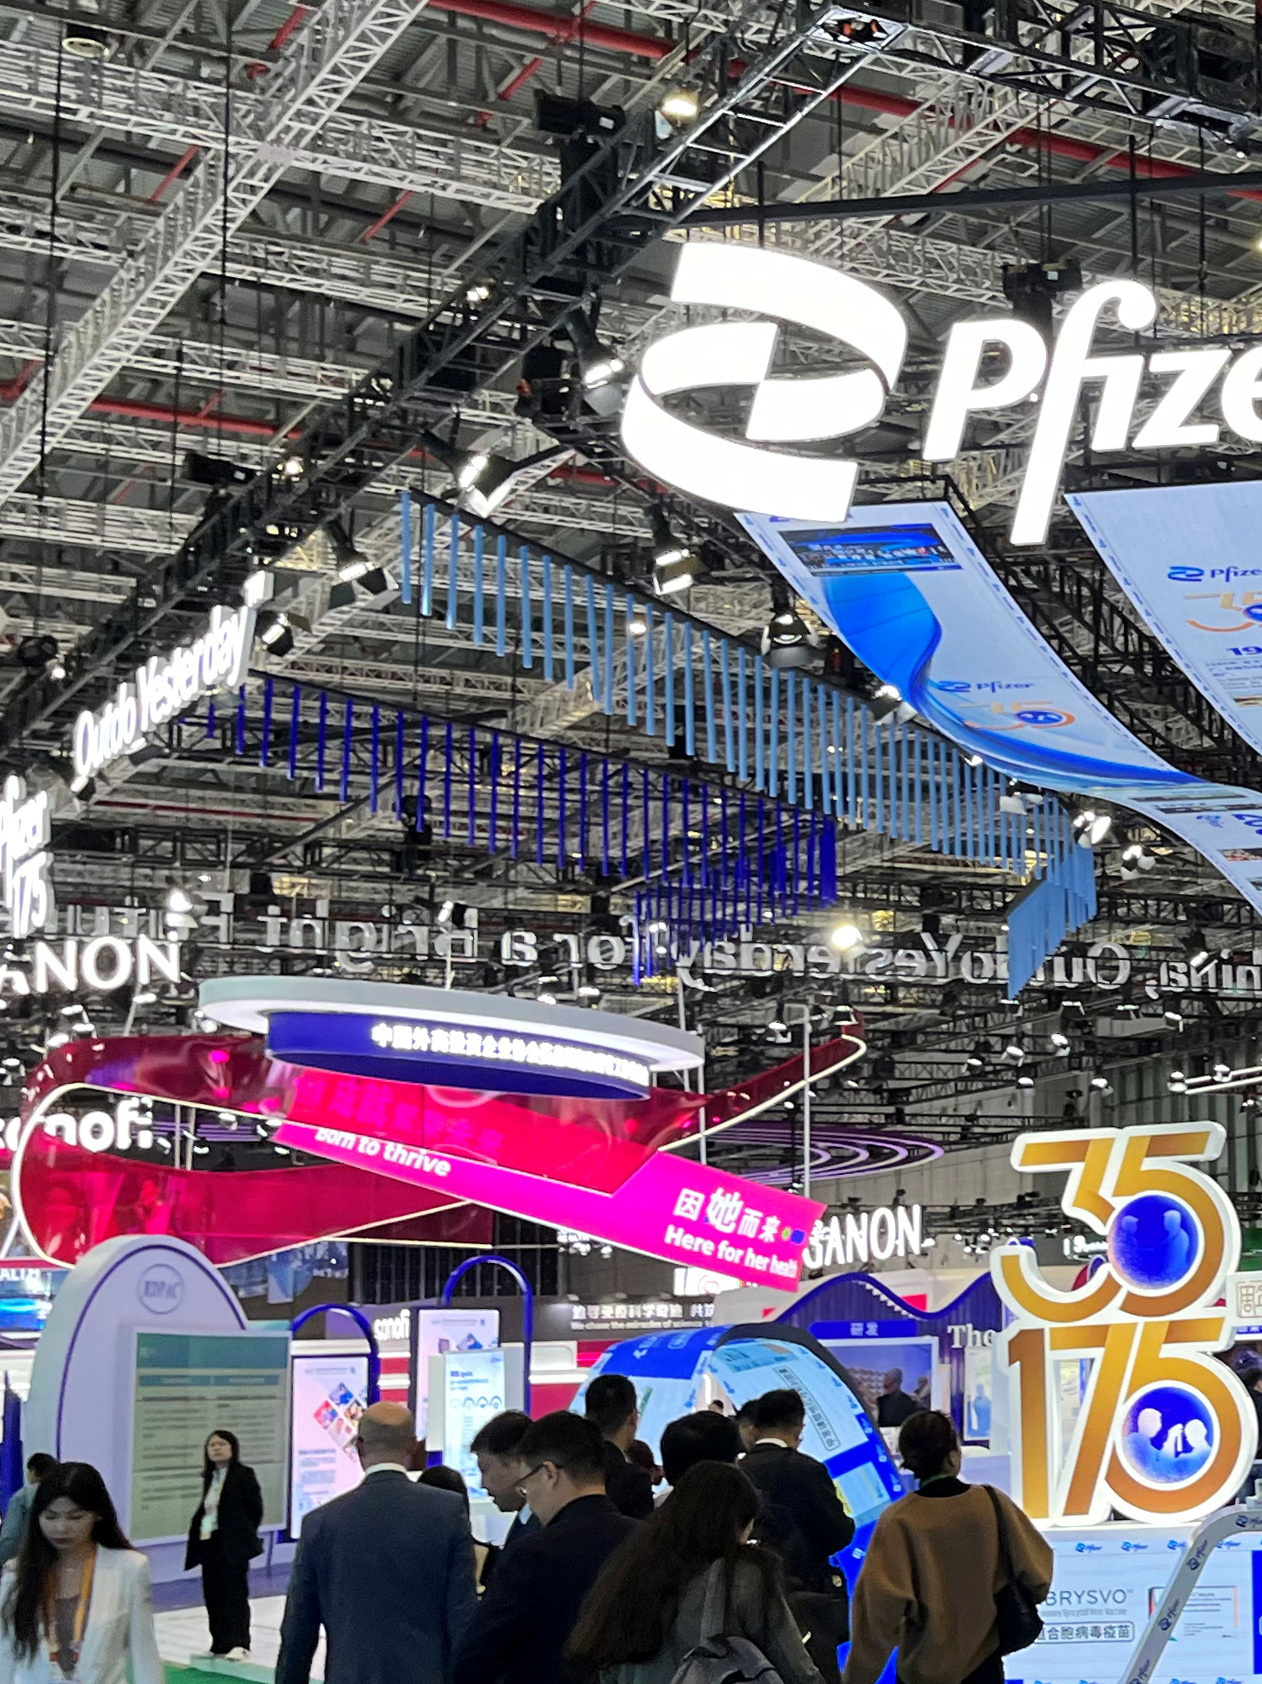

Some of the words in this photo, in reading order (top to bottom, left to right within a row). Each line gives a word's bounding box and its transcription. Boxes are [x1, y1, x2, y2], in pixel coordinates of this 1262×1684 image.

[977, 682, 1034, 693] Pfizer
[314, 1128, 356, 1150] Born
[358, 1135, 380, 1156] to
[383, 1144, 451, 1176] thrive
[674, 1187, 781, 1243] 因她而来
[996, 1127, 1232, 1325] 35
[664, 1224, 715, 1257] Here
[717, 1240, 744, 1263] for
[744, 1247, 768, 1272] her
[850, 1322, 879, 1336] 研发
[947, 1323, 994, 1348] The
[1005, 1315, 1245, 1522] 175
